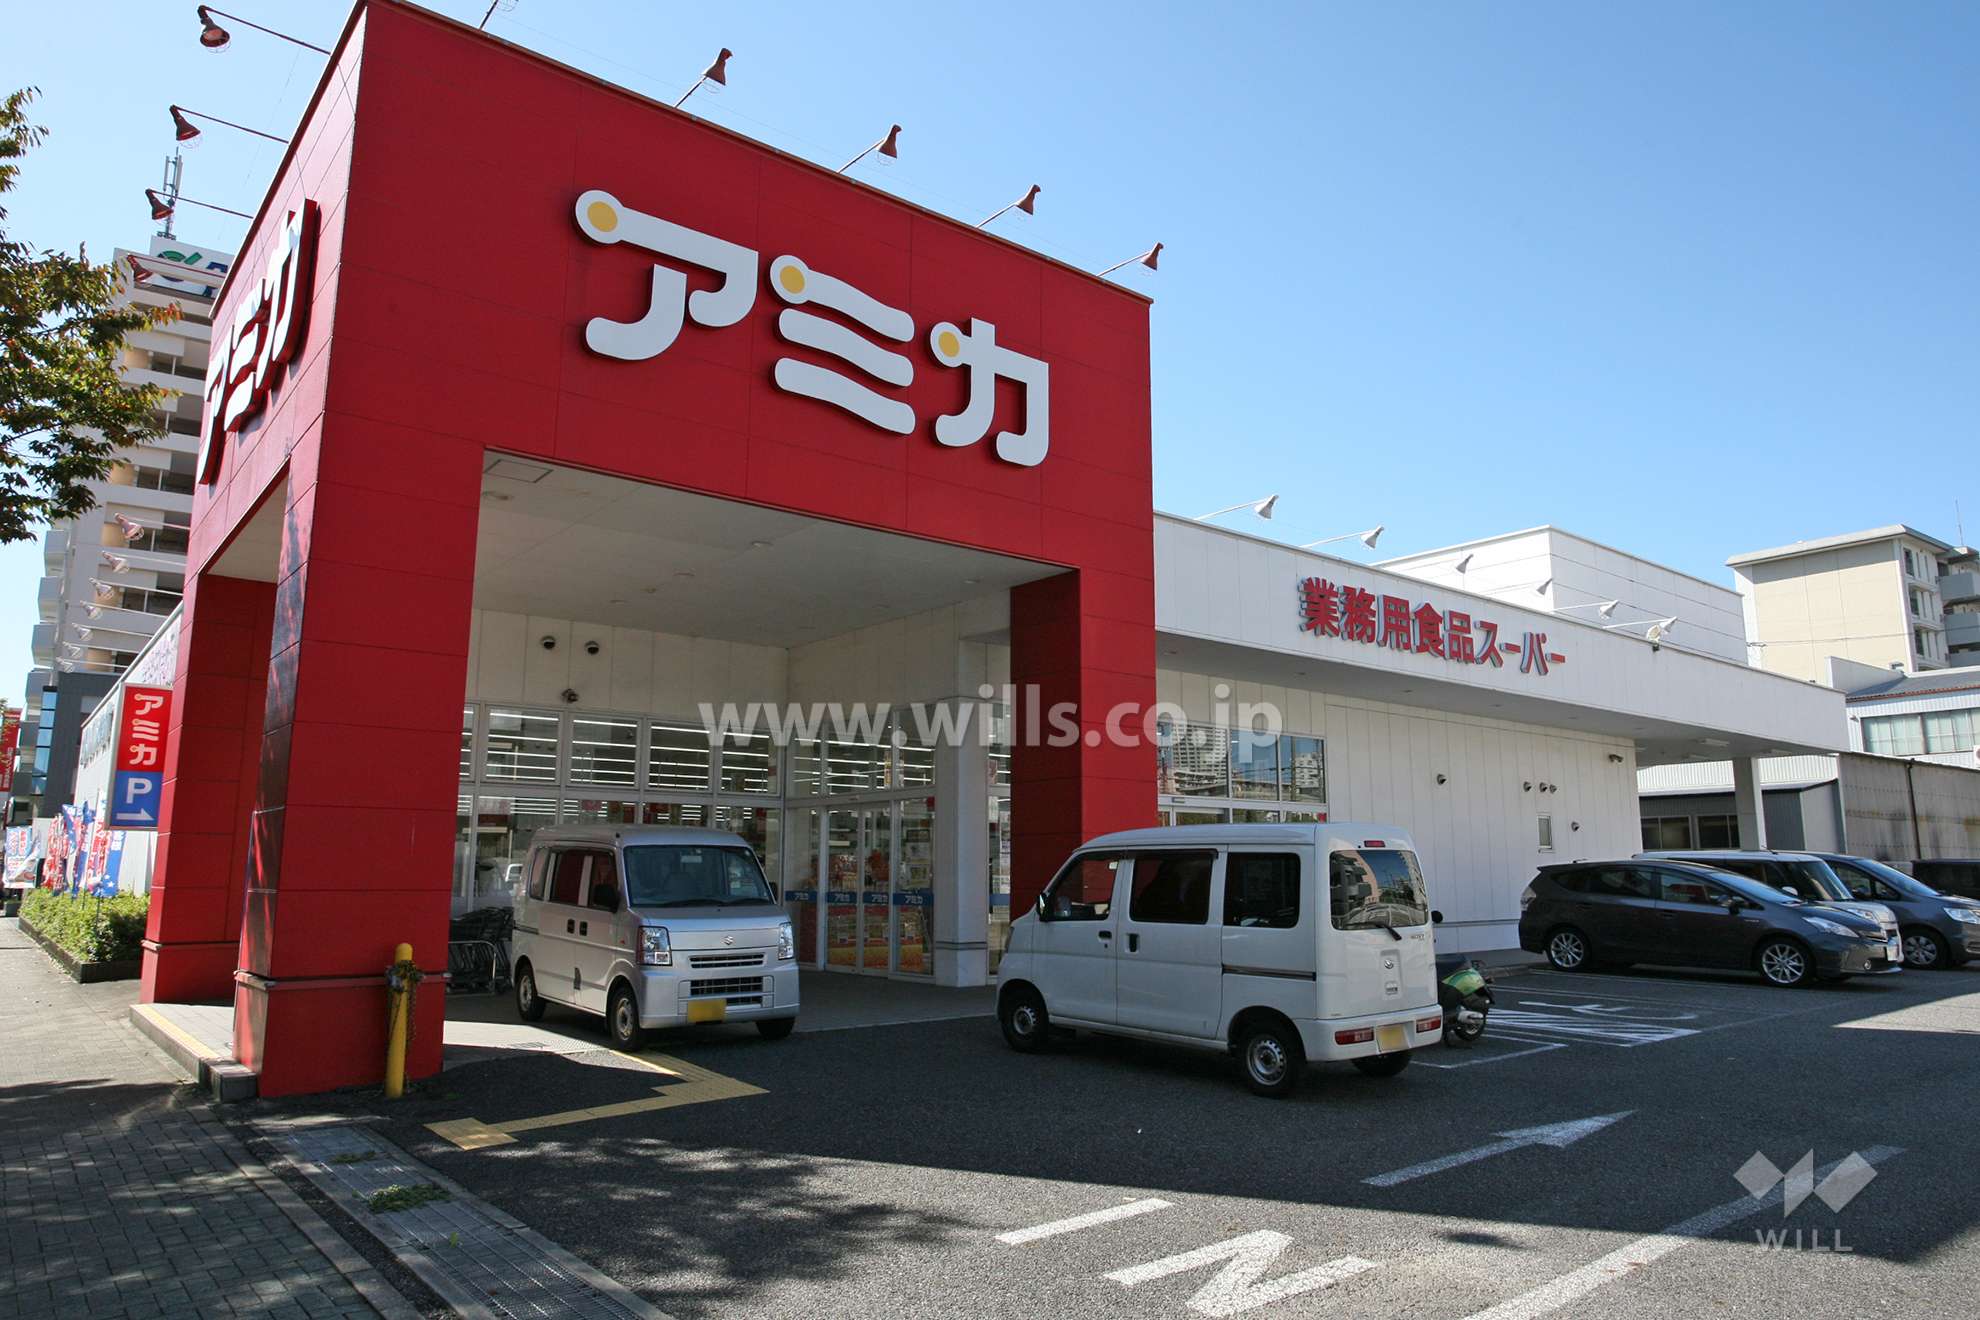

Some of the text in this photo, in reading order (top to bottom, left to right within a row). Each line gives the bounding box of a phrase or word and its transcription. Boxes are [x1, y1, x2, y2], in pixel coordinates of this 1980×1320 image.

[575, 189, 1049, 467] アミカ
[1299, 576, 1566, 676] 業務用食品スーパー
[129, 693, 164, 766] アミカ
[126, 777, 153, 804] P
